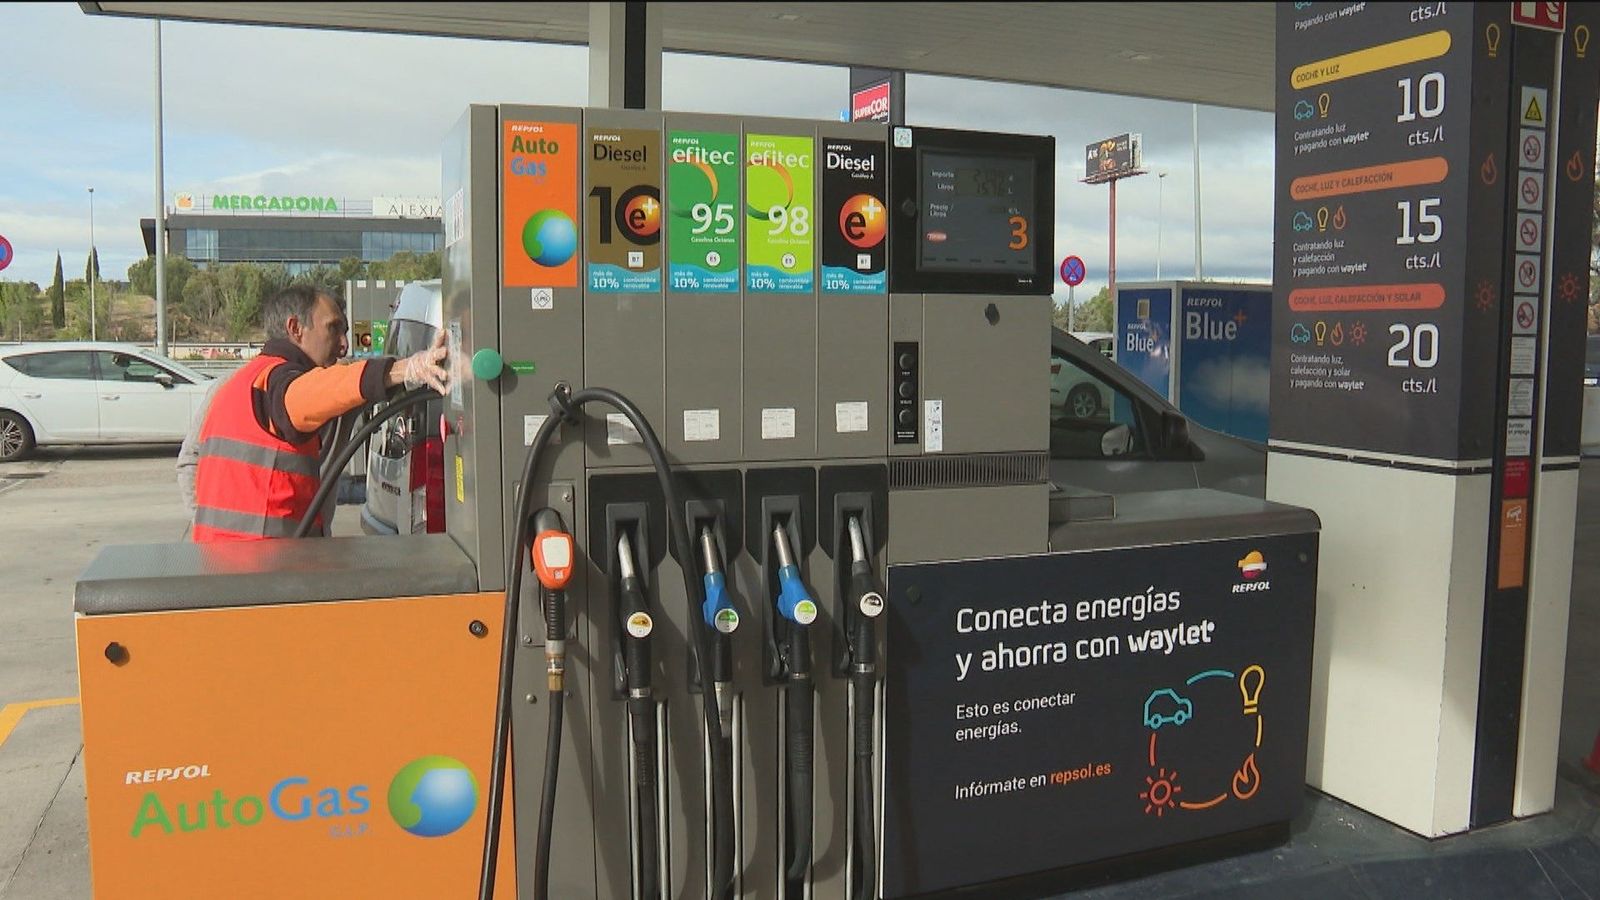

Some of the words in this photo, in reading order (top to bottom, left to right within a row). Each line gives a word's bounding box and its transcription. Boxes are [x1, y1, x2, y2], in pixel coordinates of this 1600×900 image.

[1294, 13, 1323, 30] Pagando
[1324, 11, 1337, 22] con
[1338, 2, 1366, 17] waylet
[1410, 2, 1447, 23] cts./l
[1296, 69, 1319, 83] COCHE
[1319, 67, 1325, 77] Y
[1325, 64, 1340, 75] LUZ
[1397, 71, 1445, 123] 10
[511, 125, 544, 133] REPSOL
[1294, 126, 1335, 141] Contratando
[1335, 123, 1346, 132] luz
[1408, 126, 1444, 146] cts./l
[511, 135, 559, 155] Auto
[1294, 144, 1299, 156] y
[1299, 138, 1327, 153] pagando
[1328, 137, 1342, 147] con
[1342, 130, 1370, 146] waylet
[593, 143, 647, 163] Diesel
[672, 146, 735, 165] efitec
[750, 150, 809, 168] efitec
[827, 152, 875, 171] Diesel
[511, 155, 547, 176] Gas
[931, 170, 955, 178] Importe
[1320, 180, 1334, 190] LUZ
[1335, 179, 1340, 188] Y
[1340, 172, 1393, 189] CALEFACCIÓN
[212, 195, 338, 211] MERCADONA
[589, 185, 661, 246] 10
[691, 203, 735, 235] 95
[768, 205, 809, 236] 98
[1396, 198, 1443, 245] 15
[1008, 215, 1029, 251] 3
[1293, 240, 1333, 252] Contratando
[1334, 238, 1345, 249] luz
[1292, 256, 1297, 266] y
[1298, 252, 1335, 263] calefacción
[1406, 252, 1441, 270] cts./l
[1292, 268, 1297, 278] y
[1297, 265, 1326, 277] pagando
[1326, 264, 1340, 273] con
[1340, 262, 1367, 276] waylet
[593, 278, 620, 289] 10%
[674, 278, 700, 289] 10%
[751, 278, 775, 289] 10%
[826, 280, 850, 290] 10%
[1187, 298, 1224, 307] REPSOL
[1393, 292, 1421, 303] SOLAR
[1387, 323, 1439, 368] 20
[1290, 353, 1331, 364] Contratando
[1290, 364, 1327, 375] calefacción
[1328, 368, 1332, 378] y
[1333, 366, 1351, 376] solar
[1290, 379, 1295, 388] y
[1295, 377, 1323, 389] pagando
[1323, 380, 1337, 388] con
[1338, 379, 1365, 392] waylet
[1402, 377, 1437, 393] cts./l
[1232, 581, 1271, 594] REPSOL
[955, 600, 1067, 633] Conecta
[1075, 586, 1180, 622] energías
[955, 651, 973, 681] y
[981, 642, 1067, 672] ahorra
[1076, 635, 1120, 660] con
[1128, 620, 1215, 655] waylet
[956, 703, 989, 720] Esto
[993, 702, 1010, 716] es
[1013, 692, 1076, 712] conectar
[955, 720, 1022, 742] energías.
[126, 765, 211, 785] REPSOL
[955, 774, 1026, 800] Infórmate
[1029, 773, 1047, 787] en
[1050, 762, 1112, 789] repsol.es
[130, 776, 370, 839] AutoGas
